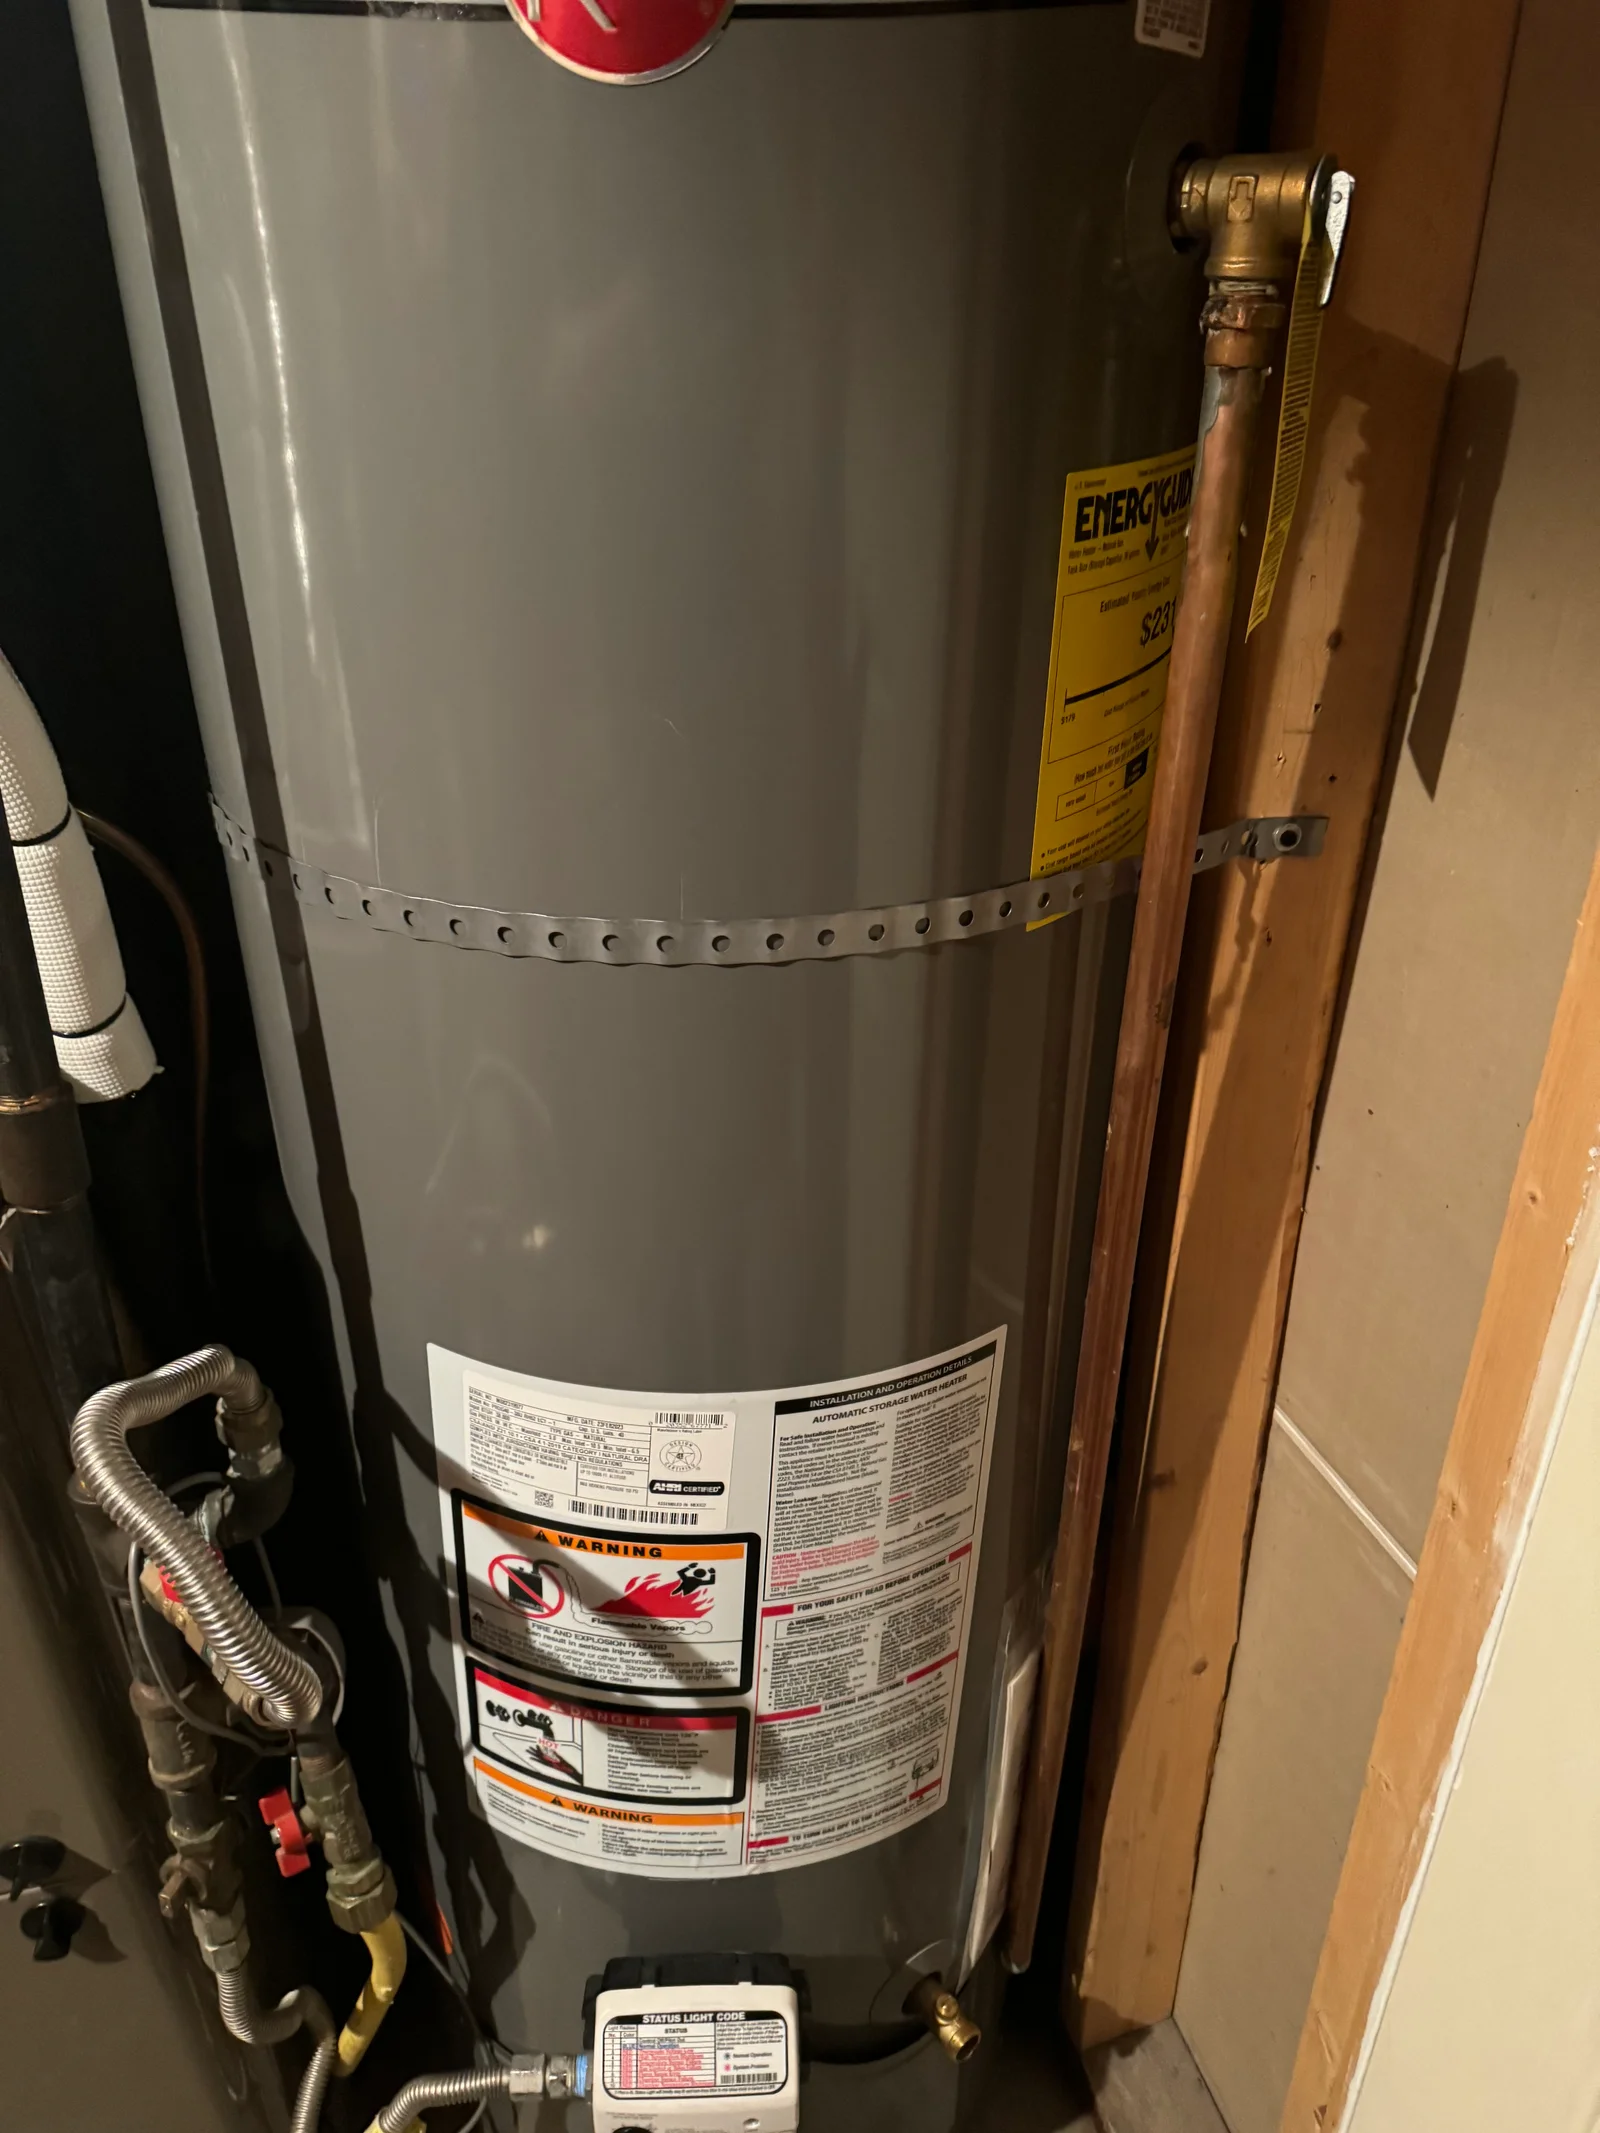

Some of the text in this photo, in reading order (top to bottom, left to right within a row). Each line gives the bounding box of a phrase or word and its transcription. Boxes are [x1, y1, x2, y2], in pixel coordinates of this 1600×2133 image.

[1074, 471, 1194, 543] ENERGYGUID
[1100, 594, 1129, 613] Estimated
[1061, 713, 1075, 725] $179
[1107, 742, 1120, 756] First
[1047, 846, 1056, 857] Your
[810, 1356, 972, 1408] INSTALLATION AND OPERATION DETAILS
[813, 1374, 968, 1424] AUTOMATIC STORAGE WATER HEATER
[804, 1429, 836, 1438] Installation
[850, 1420, 876, 1430] Operation
[817, 1439, 836, 1447] owner's
[837, 1436, 855, 1444] manual
[861, 1430, 878, 1440] missing
[837, 1430, 851, 1439] heater
[853, 1425, 875, 1435] warnings
[524, 1434, 536, 1444] CSA
[562, 1445, 596, 1456] CATEGORY
[602, 1451, 632, 1461] NATURAL
[790, 1456, 814, 1464] appliance
[836, 1448, 855, 1458] installed
[862, 1440, 888, 1452] accordance
[808, 1447, 826, 1455] retailer
[841, 1452, 860, 1461] absence
[866, 1448, 877, 1456] local
[589, 1456, 623, 1467] REGULATIONS
[822, 1489, 847, 1499] Regardless
[863, 1480, 882, 1490] material
[558, 1534, 663, 1558] WARNING
[815, 1598, 834, 1608] YOUR
[836, 1592, 863, 1603] SAFETY
[865, 1585, 884, 1596] READ
[885, 1575, 910, 1589] BEFORE
[912, 1559, 946, 1579] OPERATING
[591, 1617, 685, 1632] Flammable Vapors
[795, 1615, 826, 1625] WARNING:
[532, 1622, 667, 1651] FIRE AND EXPLOSION HAZARD
[543, 1632, 566, 1645] result
[568, 1638, 576, 1647] in
[579, 1640, 609, 1653] serious
[612, 1647, 636, 1658] injury
[650, 1651, 674, 1659] death
[539, 1641, 553, 1651] use
[555, 1644, 587, 1657] gasoline
[599, 1651, 617, 1661] other
[619, 1654, 661, 1666] flammable
[709, 1659, 735, 1667] liquids
[563, 1653, 582, 1663] other
[625, 1663, 657, 1674] Storage
[705, 1666, 738, 1674] gasoline
[572, 1662, 597, 1674] liquids
[607, 1668, 618, 1676] the
[622, 1669, 648, 1679] vicinity
[702, 1673, 722, 1681] other
[577, 1670, 597, 1680] injury
[824, 1680, 904, 1710] LIGHTING INSTRUCTIONS
[570, 1707, 651, 1727] DANGER
[538, 1737, 559, 1749] HOT
[573, 1802, 653, 1823] WARNING
[803, 1831, 820, 1839] TURN
[876, 1799, 907, 1816] APPLIANCE
[643, 2012, 745, 2023] STATUS LIGHT CODE
